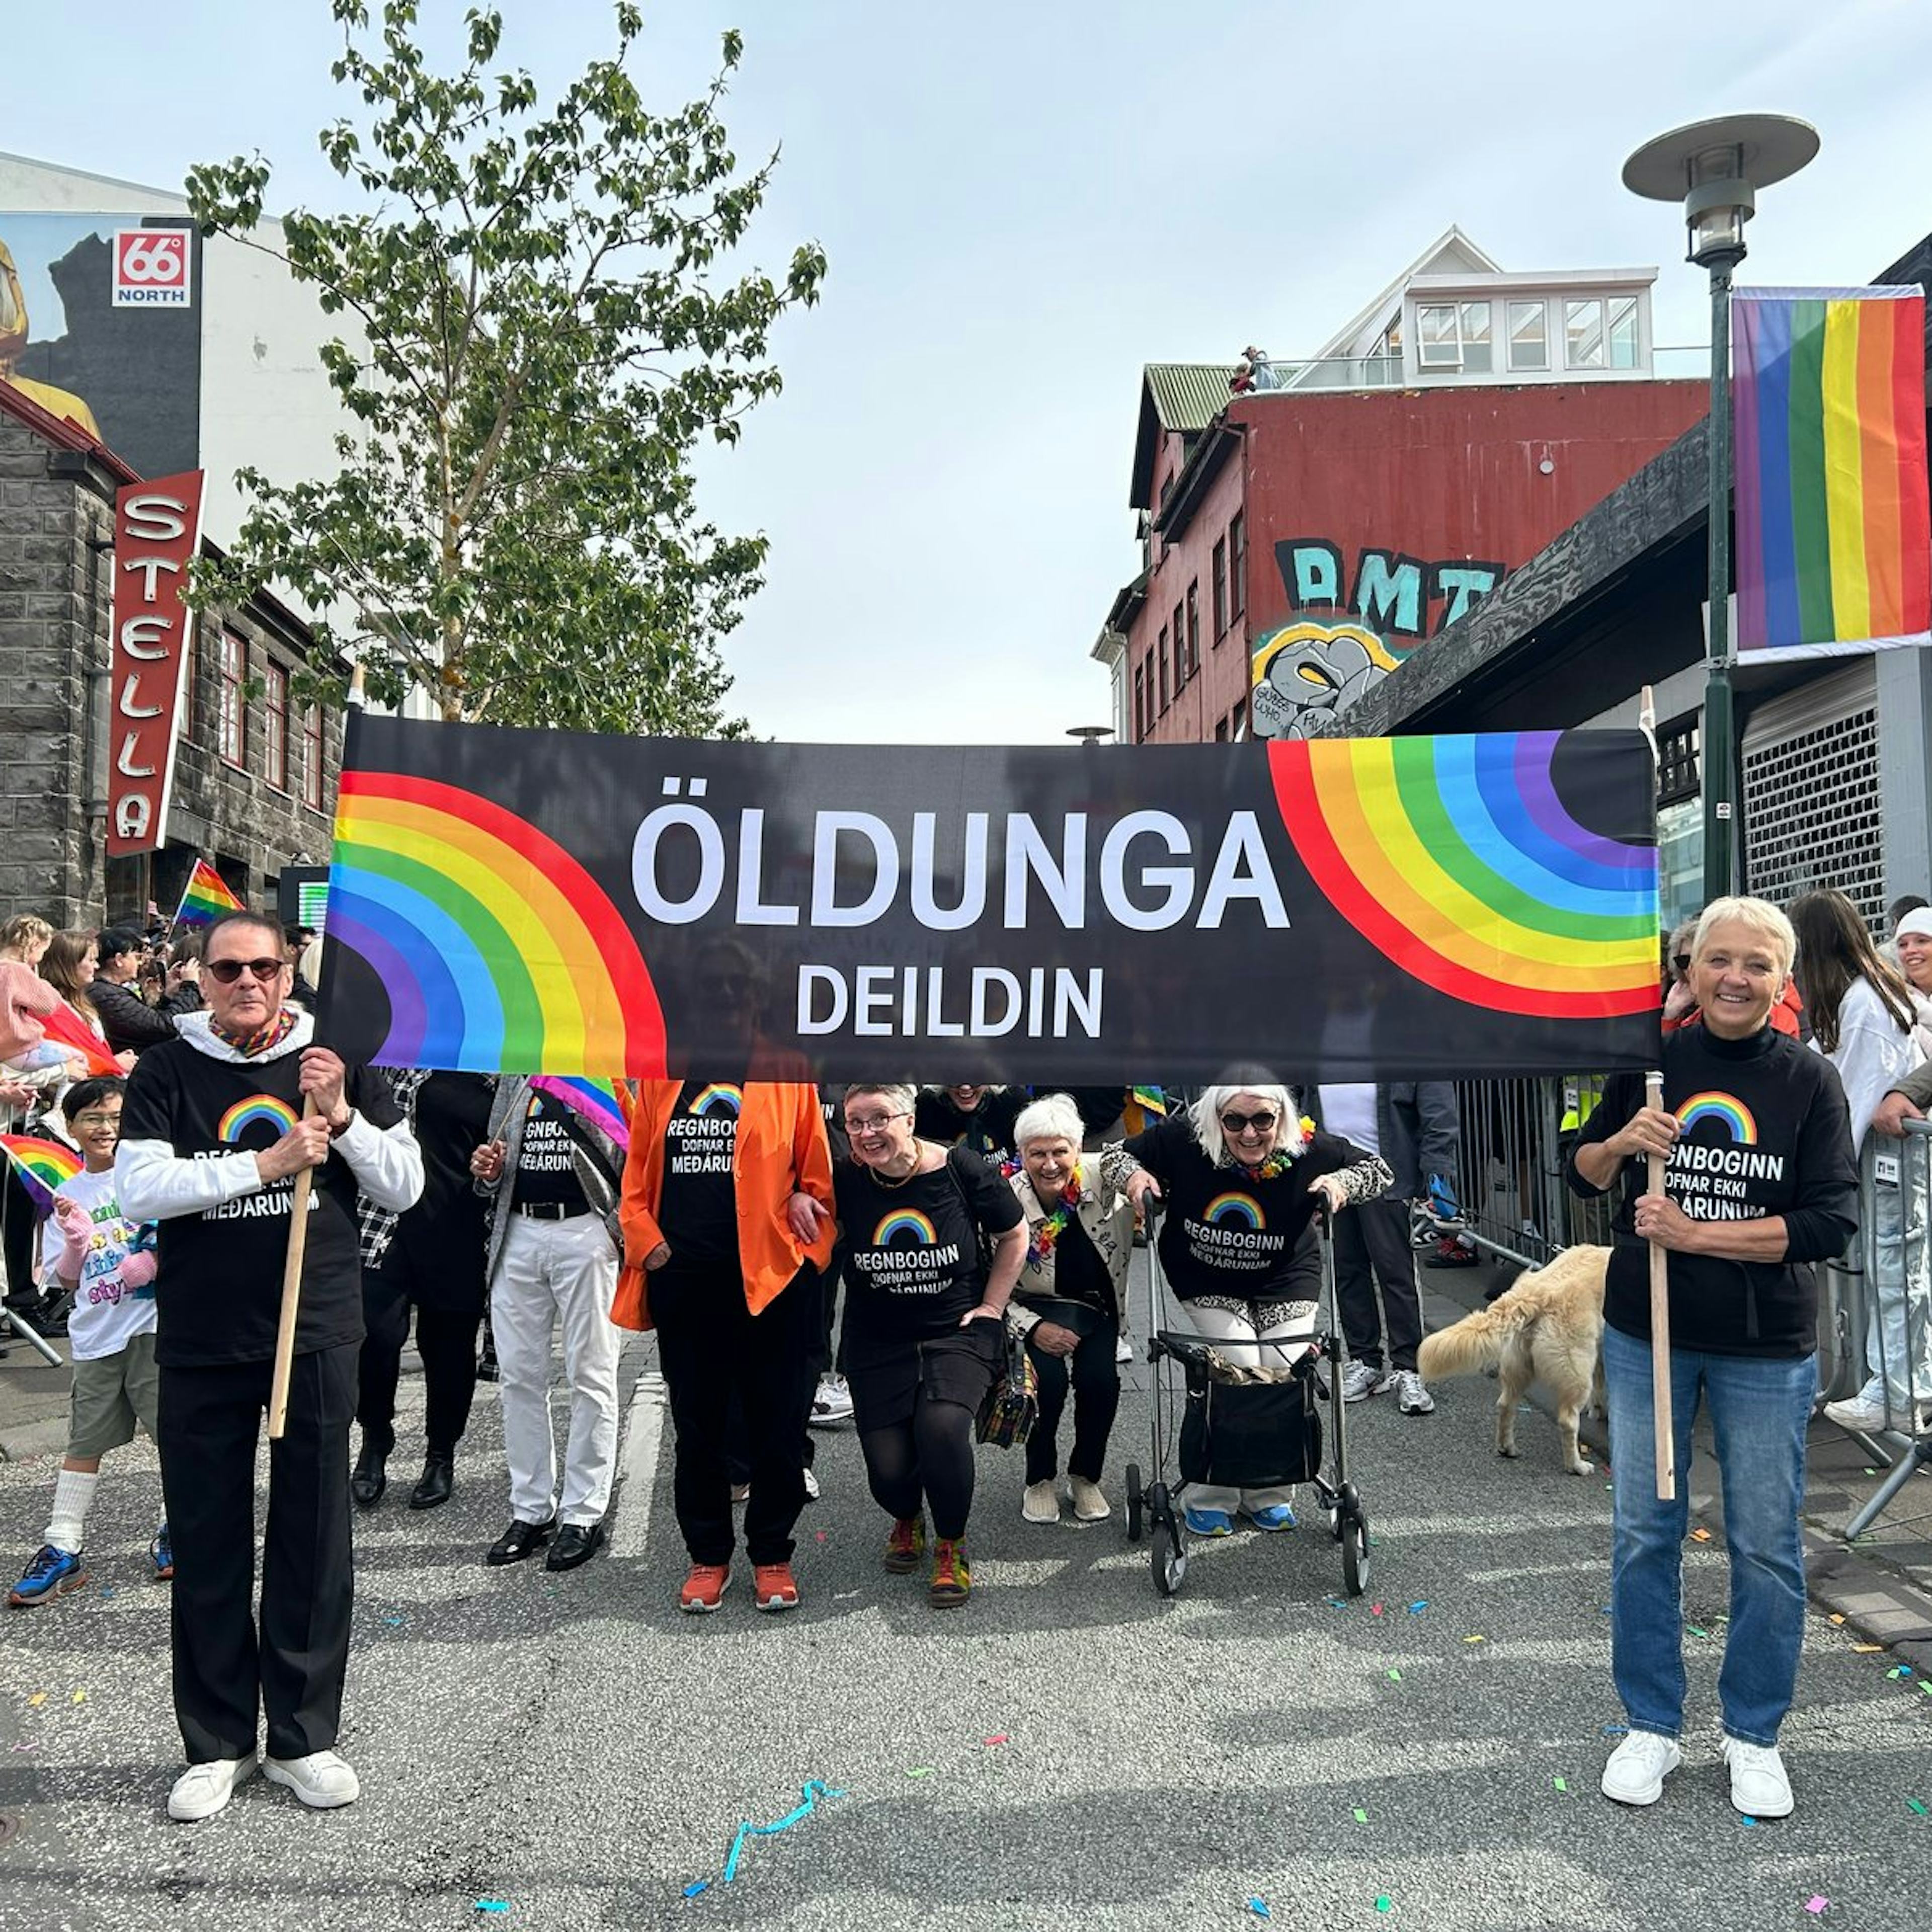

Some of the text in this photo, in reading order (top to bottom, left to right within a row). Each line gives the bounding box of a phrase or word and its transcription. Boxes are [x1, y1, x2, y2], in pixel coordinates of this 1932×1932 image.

[118, 289, 184, 301] NORTH
[115, 494, 188, 839] STELLA
[631, 776, 1291, 931] ÖLDUNGA
[797, 964, 1104, 1038] DEILDIN
[682, 1139, 724, 1152] DOFNAR
[672, 1152, 735, 1174] MEÐÁRU
[1664, 1170, 1747, 1199] OFNAR EKKI
[1184, 1218, 1285, 1251] REGNBOGINN
[854, 1243, 960, 1271] REGNBOGINN
[1237, 1249, 1260, 1260] EKKI
[915, 1269, 939, 1281] EKKI
